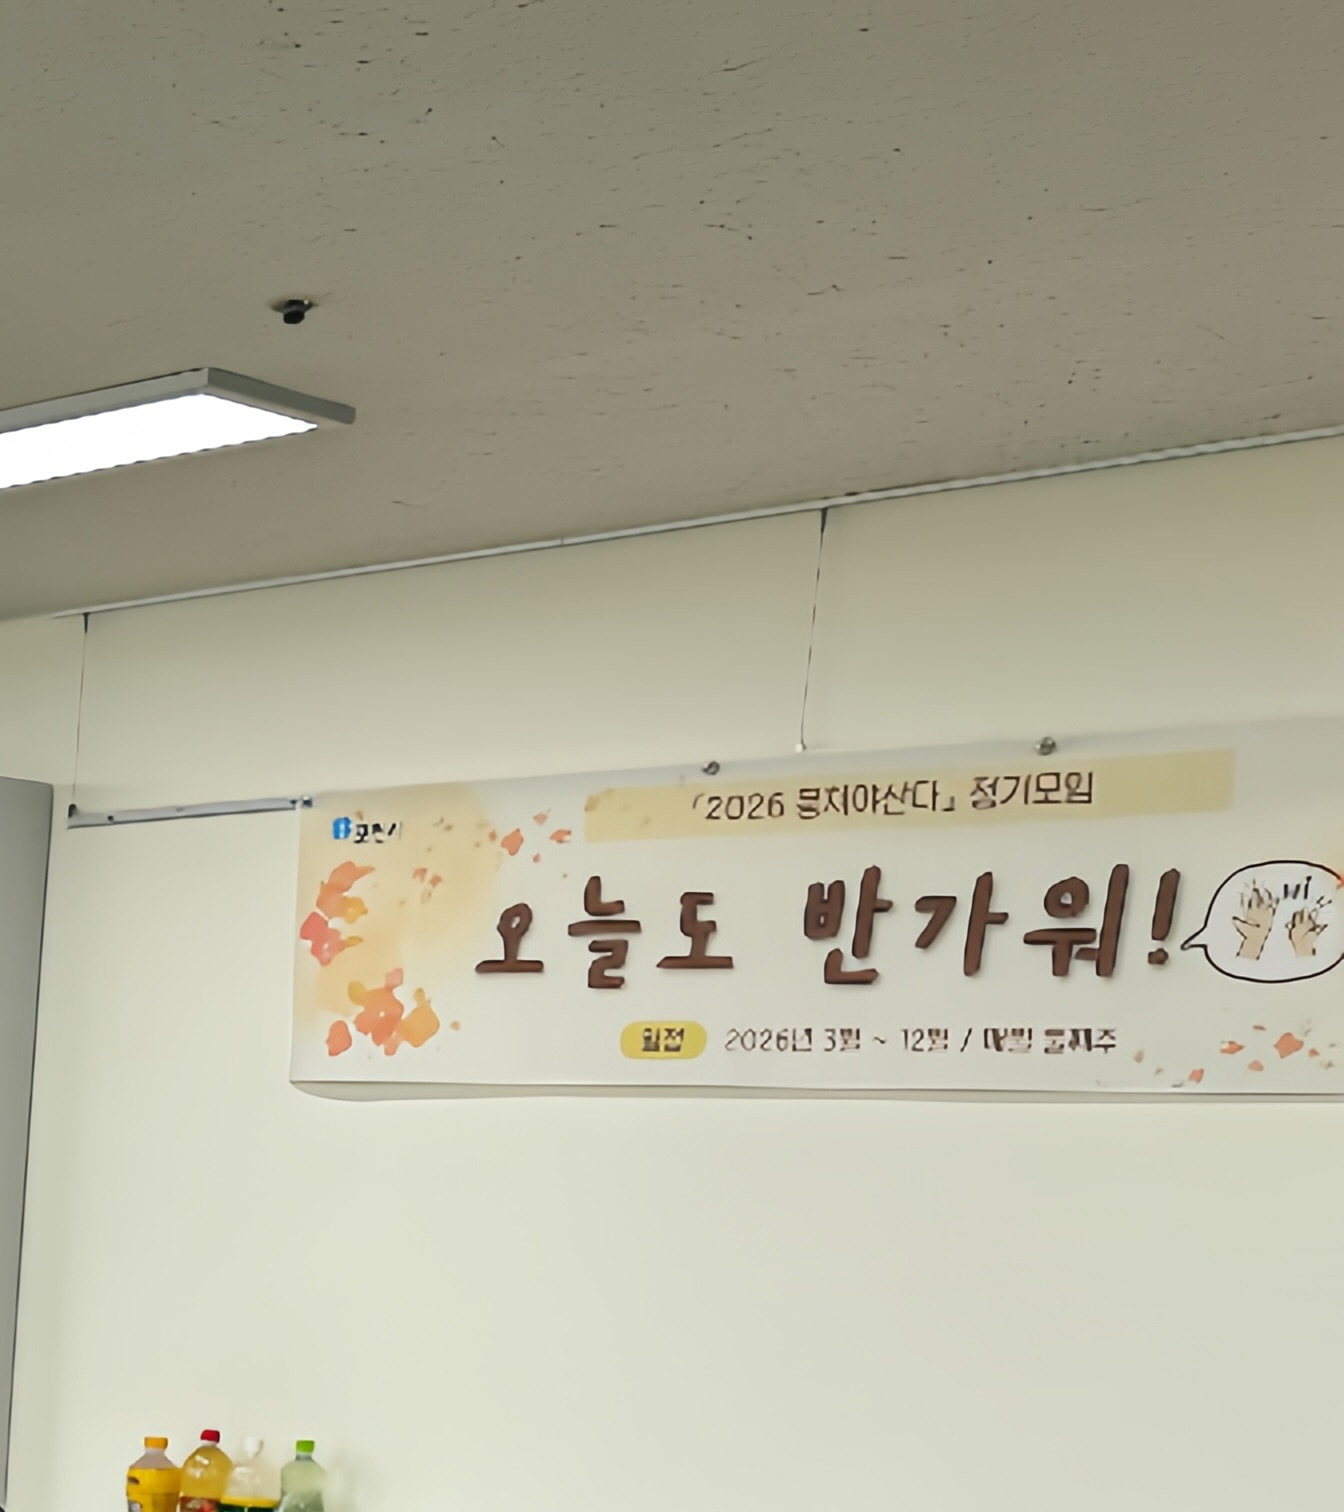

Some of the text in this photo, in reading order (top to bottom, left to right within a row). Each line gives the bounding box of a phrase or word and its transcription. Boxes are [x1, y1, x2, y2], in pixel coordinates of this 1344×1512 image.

[969, 771, 1093, 810] 정기모임
[474, 863, 1181, 990] 오늘도 반가워!
[724, 1027, 813, 1053] 2026년
[902, 1027, 949, 1053] 12월
